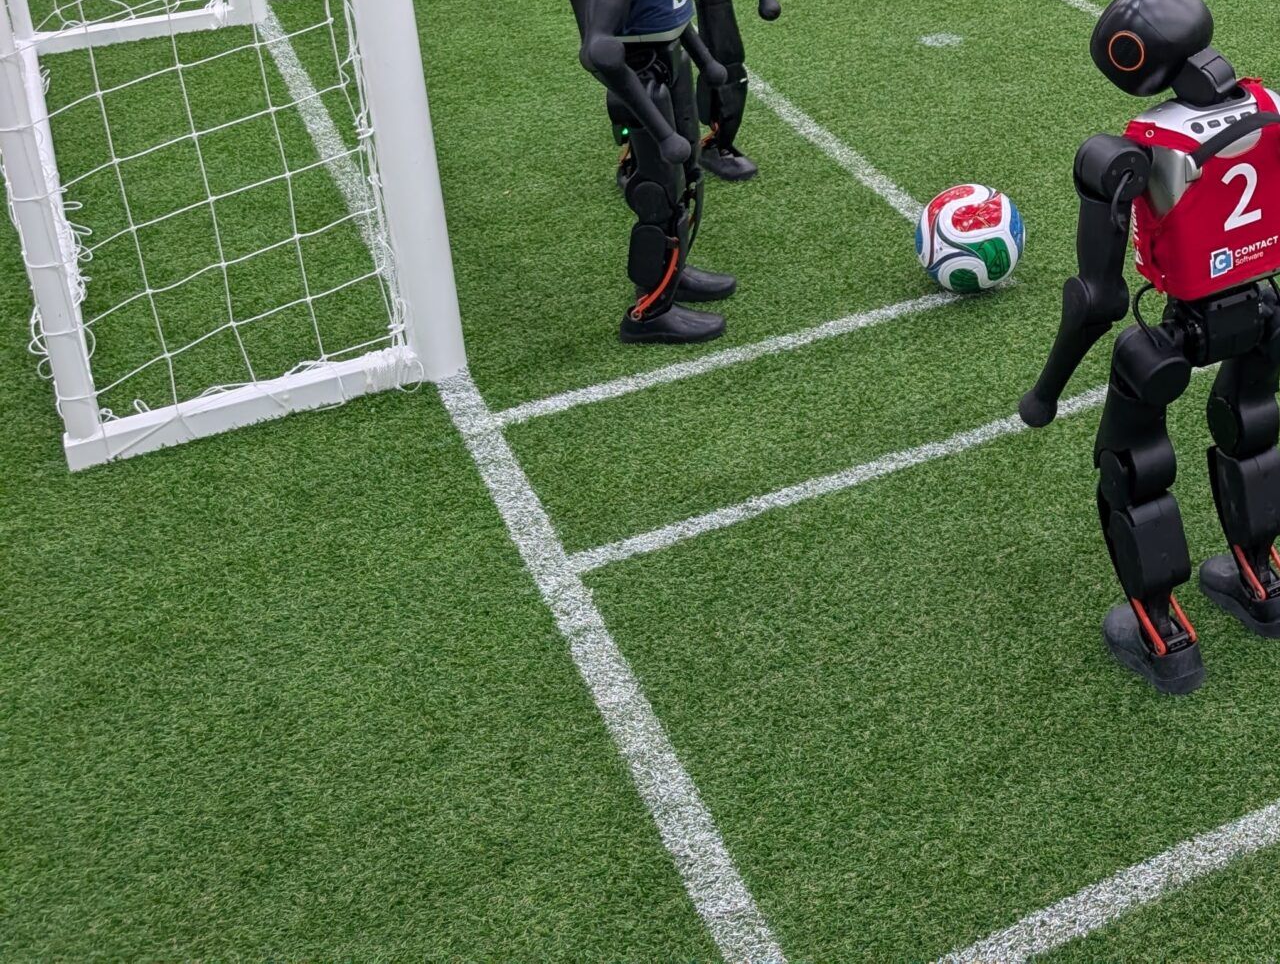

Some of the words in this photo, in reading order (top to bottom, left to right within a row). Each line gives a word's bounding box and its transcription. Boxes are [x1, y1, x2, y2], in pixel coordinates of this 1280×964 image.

[1221, 163, 1262, 232] 2
[1234, 235, 1279, 258] CONTACT
[1234, 251, 1265, 267] Software
